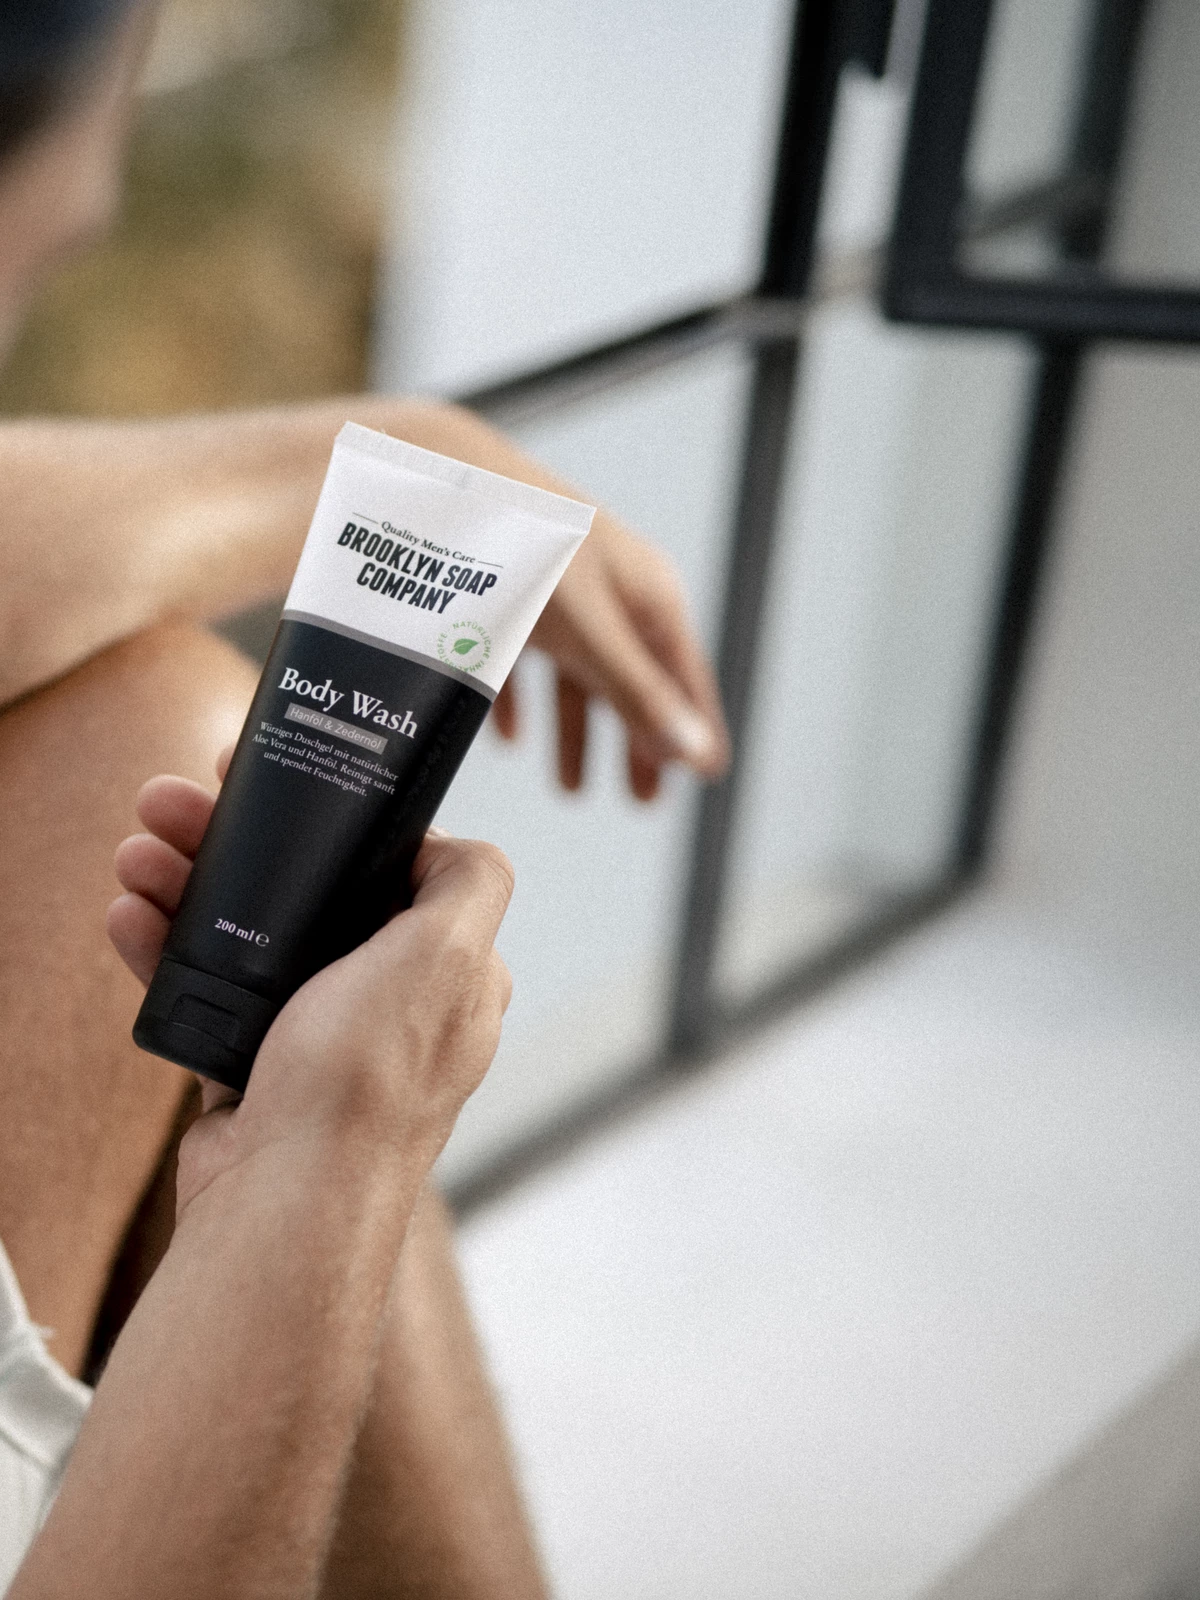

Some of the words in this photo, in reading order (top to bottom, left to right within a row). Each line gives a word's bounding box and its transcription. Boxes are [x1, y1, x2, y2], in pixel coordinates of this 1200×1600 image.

[337, 522, 445, 583] BROOKLYN
[442, 564, 498, 596] SOAP
[381, 521, 420, 545] Quality
[421, 539, 450, 557] Men's
[452, 551, 476, 563] Care
[356, 562, 457, 614] COMPANY
[437, 632, 485, 673] INHASTOFFE
[278, 667, 345, 712] Body
[352, 690, 418, 739] Wash
[260, 721, 293, 740] Würziges
[294, 732, 334, 754] Duschgel
[333, 749, 350, 760] mit
[351, 755, 399, 782] natürlicher
[290, 707, 322, 726] Hanföl
[324, 719, 333, 731] &
[334, 723, 382, 750] Zedernöl
[252, 733, 269, 744] Aloe
[270, 737, 287, 751] Vera
[287, 745, 305, 757] und
[340, 763, 372, 786] Reinigt
[373, 779, 396, 796] sanft
[263, 751, 280, 762] und
[280, 756, 313, 775] spendet
[313, 767, 368, 797] Feuchtigkeit.
[214, 918, 236, 933] 200
[236, 928, 255, 941] ml
